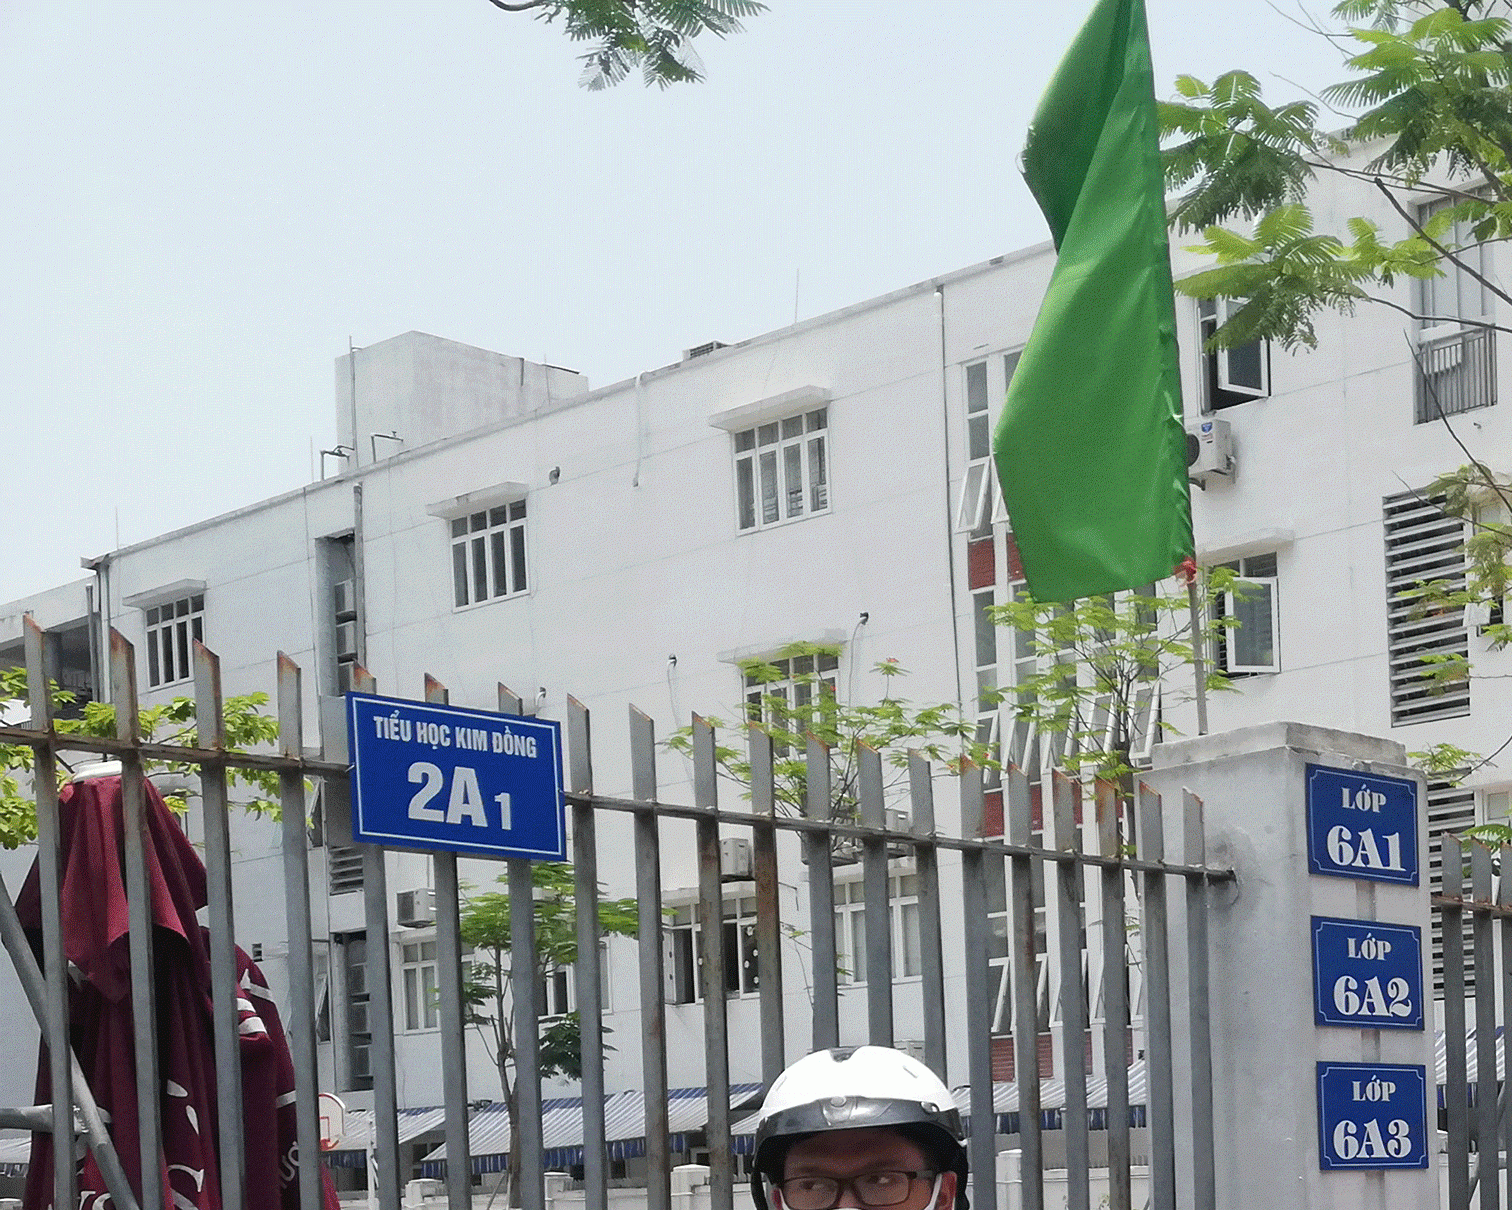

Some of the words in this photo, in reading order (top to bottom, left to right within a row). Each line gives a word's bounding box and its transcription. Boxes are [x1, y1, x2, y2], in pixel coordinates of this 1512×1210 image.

[373, 710, 412, 742] TIỂU
[416, 721, 450, 750] HỌC
[455, 726, 488, 751] KIM
[492, 725, 537, 758] ĐỒNG
[1341, 783, 1387, 813] LỚP
[1326, 825, 1407, 873] 6A1
[1347, 932, 1392, 961] LỚP
[1333, 975, 1412, 1018] 6A2
[1352, 1075, 1396, 1102] LỚP
[1333, 1118, 1412, 1160] 6A3
